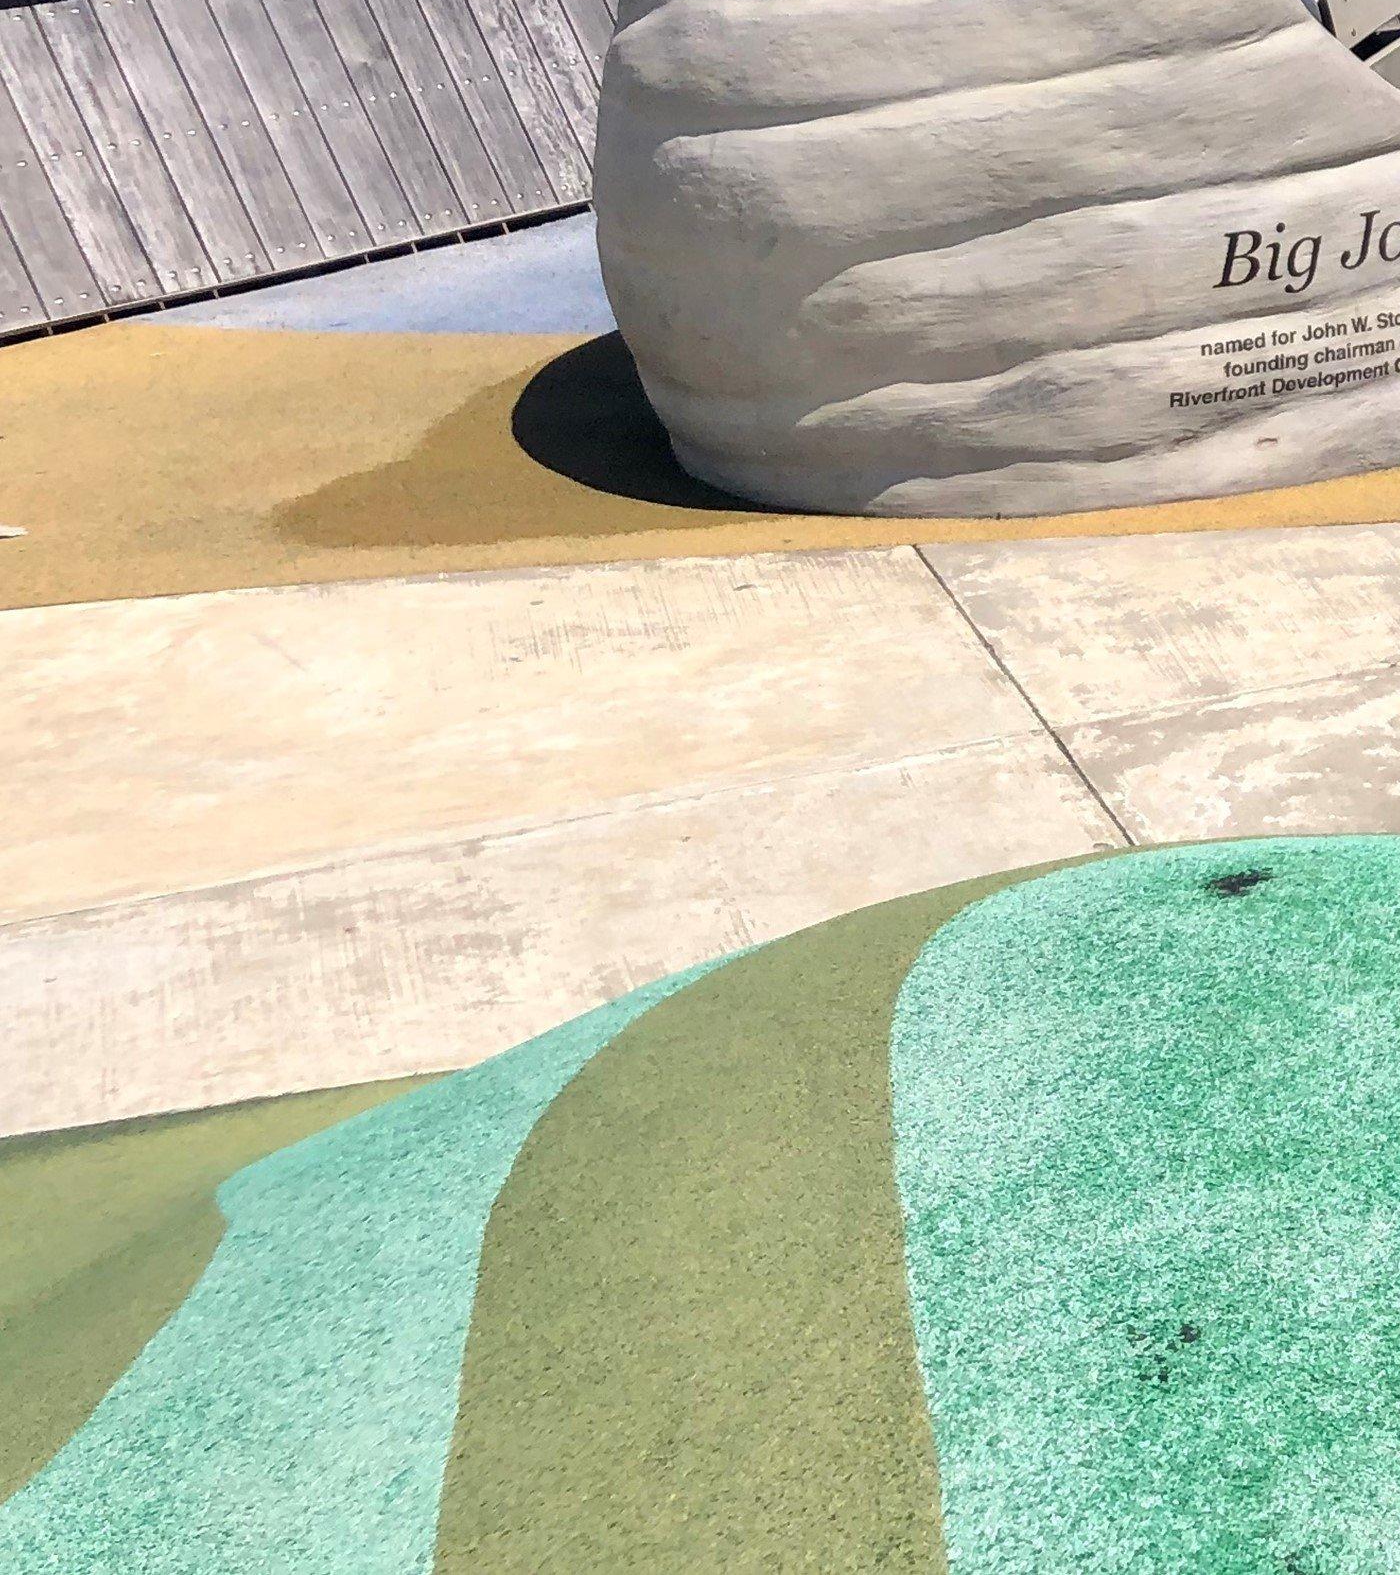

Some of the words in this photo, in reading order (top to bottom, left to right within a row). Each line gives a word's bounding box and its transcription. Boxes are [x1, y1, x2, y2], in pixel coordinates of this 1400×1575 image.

[1212, 222, 1322, 294] Big
[1201, 332, 1266, 357] named
[1271, 330, 1297, 347] for
[1302, 321, 1348, 342] John
[1351, 315, 1373, 333] W.
[1223, 354, 1309, 378] founding
[1314, 339, 1396, 363] chairman
[1169, 380, 1266, 408] Riverfront
[1272, 361, 1390, 394] Development
